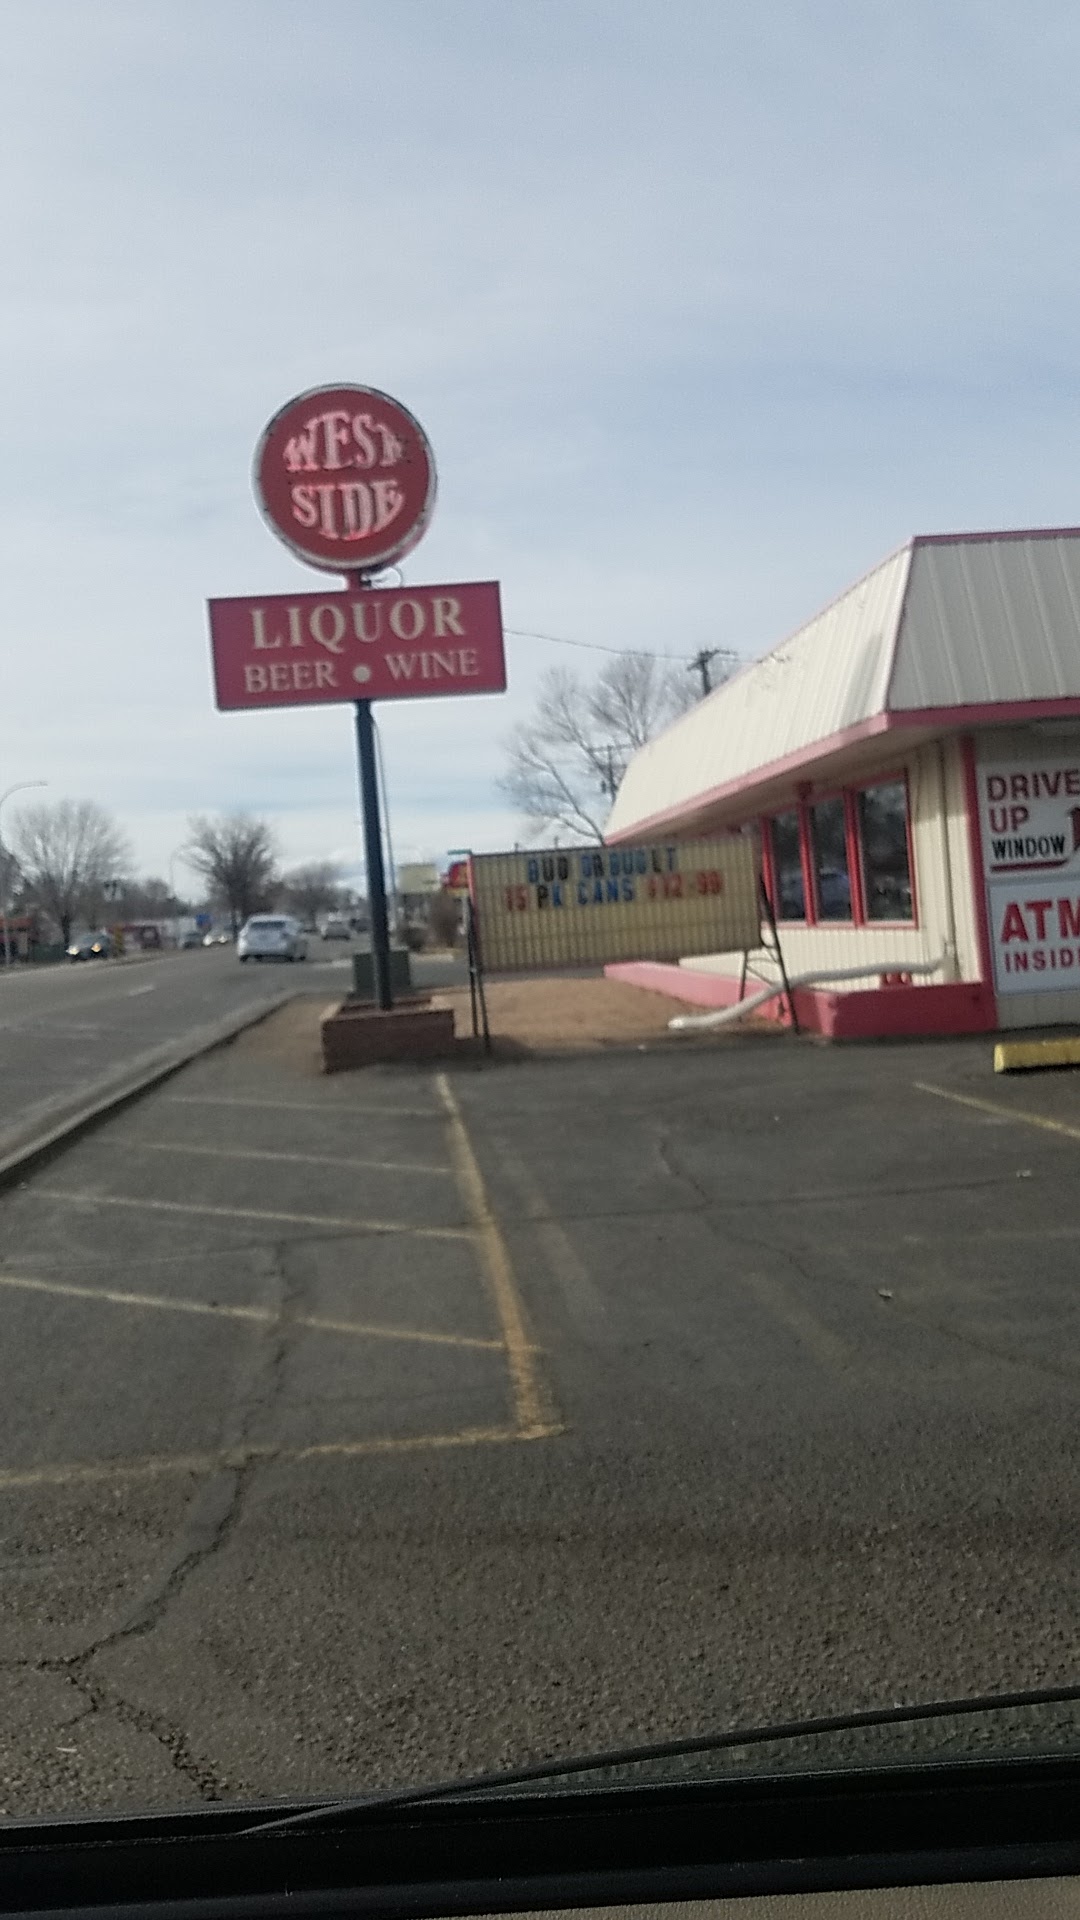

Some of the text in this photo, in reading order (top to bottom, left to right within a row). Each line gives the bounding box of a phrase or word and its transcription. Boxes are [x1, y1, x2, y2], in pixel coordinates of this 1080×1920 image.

[282, 410, 402, 472] WEST
[291, 480, 404, 541] SIDE
[252, 598, 465, 654] LIQUOR
[244, 649, 479, 693] BEER WINE
[989, 806, 1029, 834] UP
[992, 835, 1066, 860] WINDOW
[577, 874, 634, 906] CANS
[1004, 946, 1080, 973] INSID
